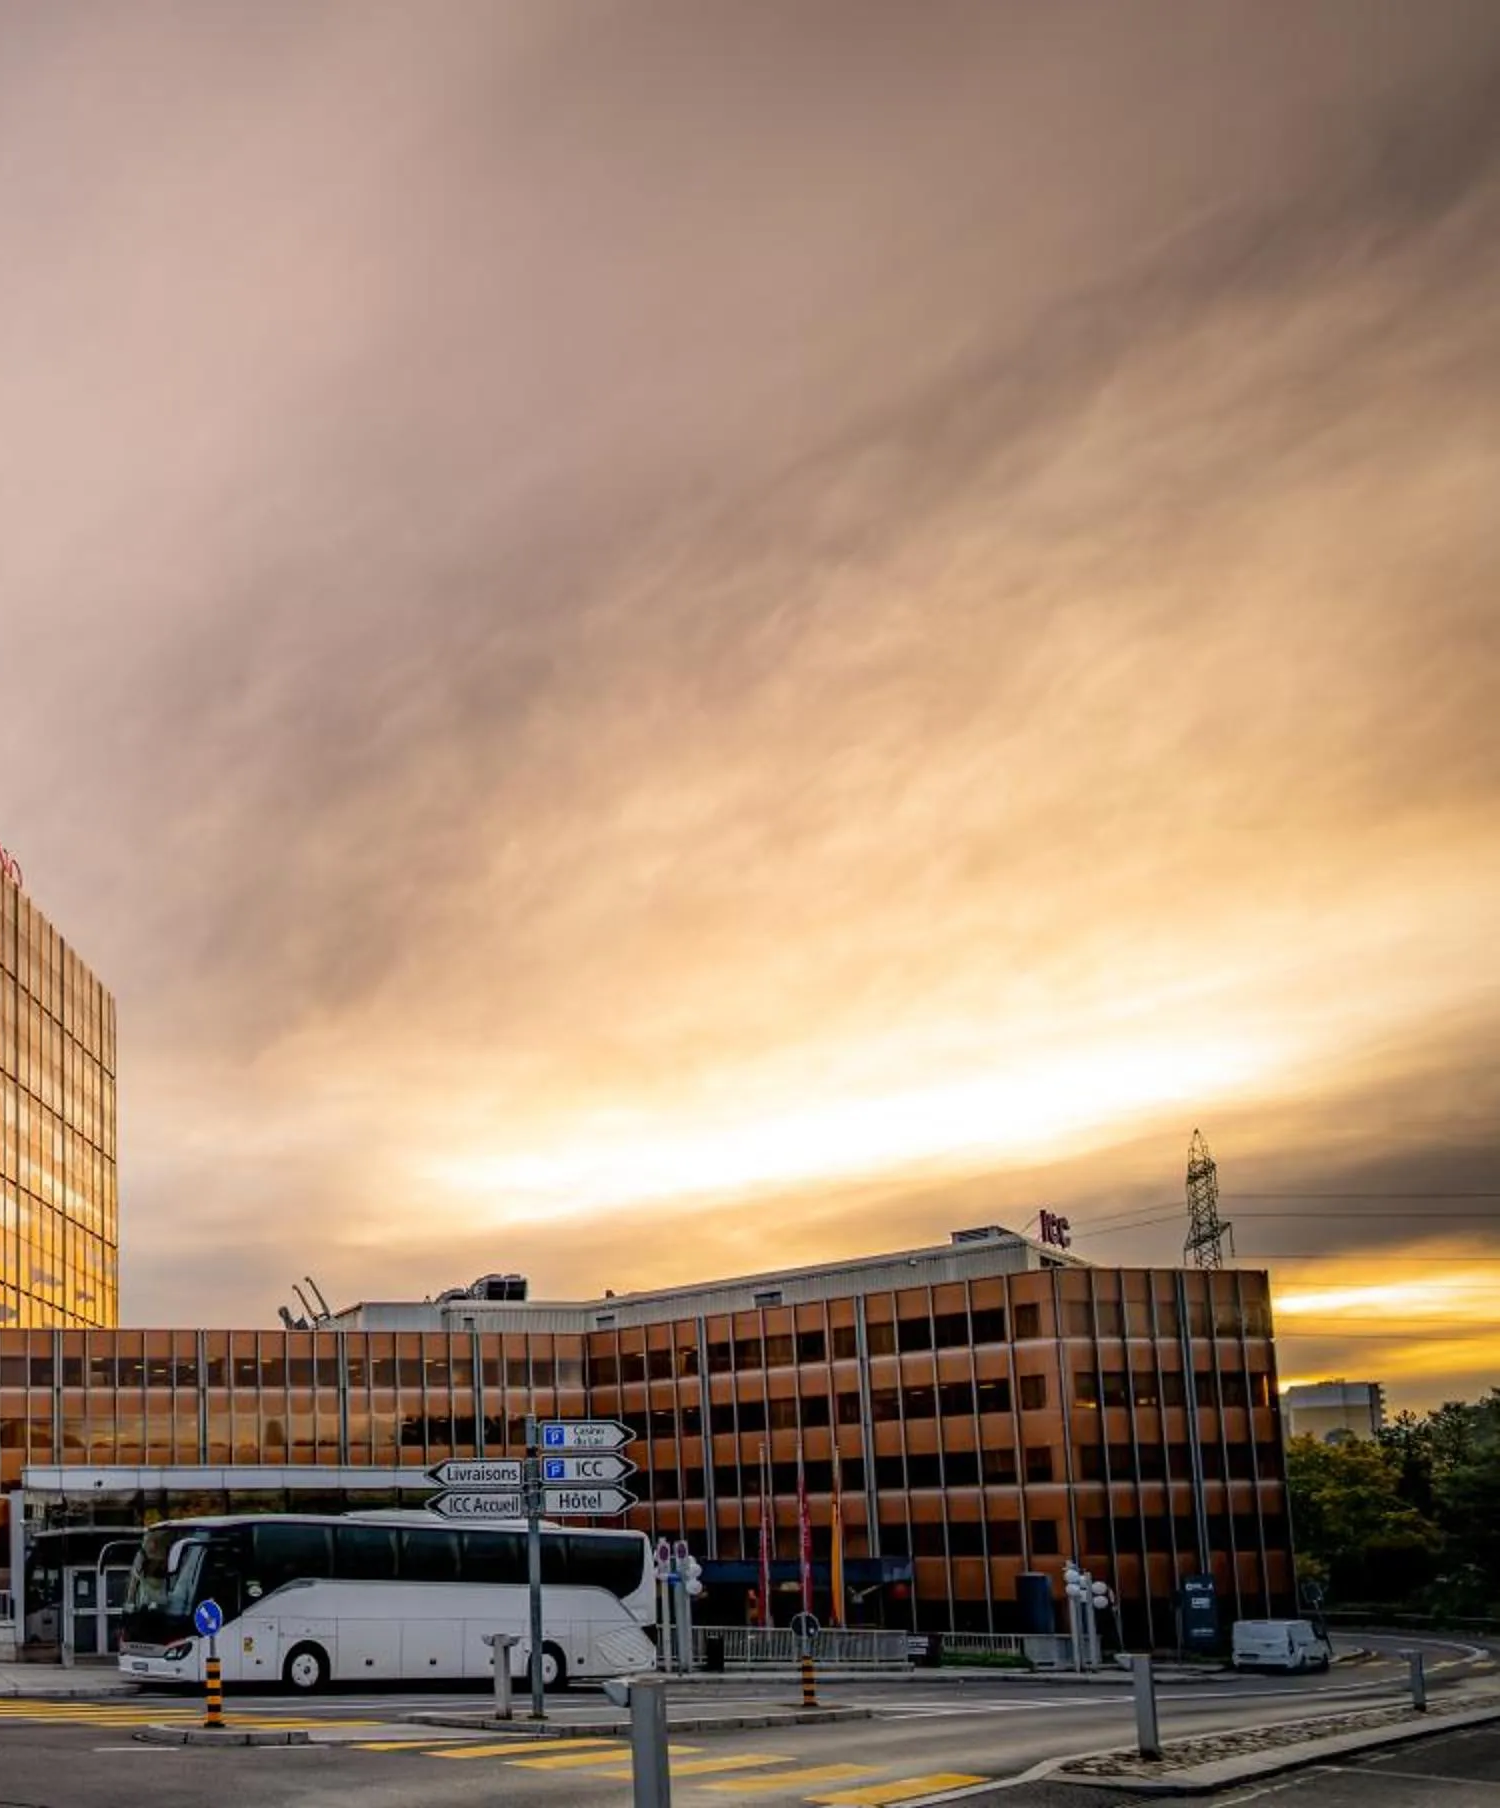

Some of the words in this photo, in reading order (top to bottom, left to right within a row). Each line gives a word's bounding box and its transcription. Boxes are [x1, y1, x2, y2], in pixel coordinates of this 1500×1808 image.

[1040, 1209, 1071, 1249] ICC
[447, 1465, 518, 1481] Livraisons
[576, 1461, 604, 1477] ICC
[449, 1497, 471, 1513] ICC
[473, 1496, 519, 1513] Accueil
[559, 1491, 602, 1509] Hôtel
